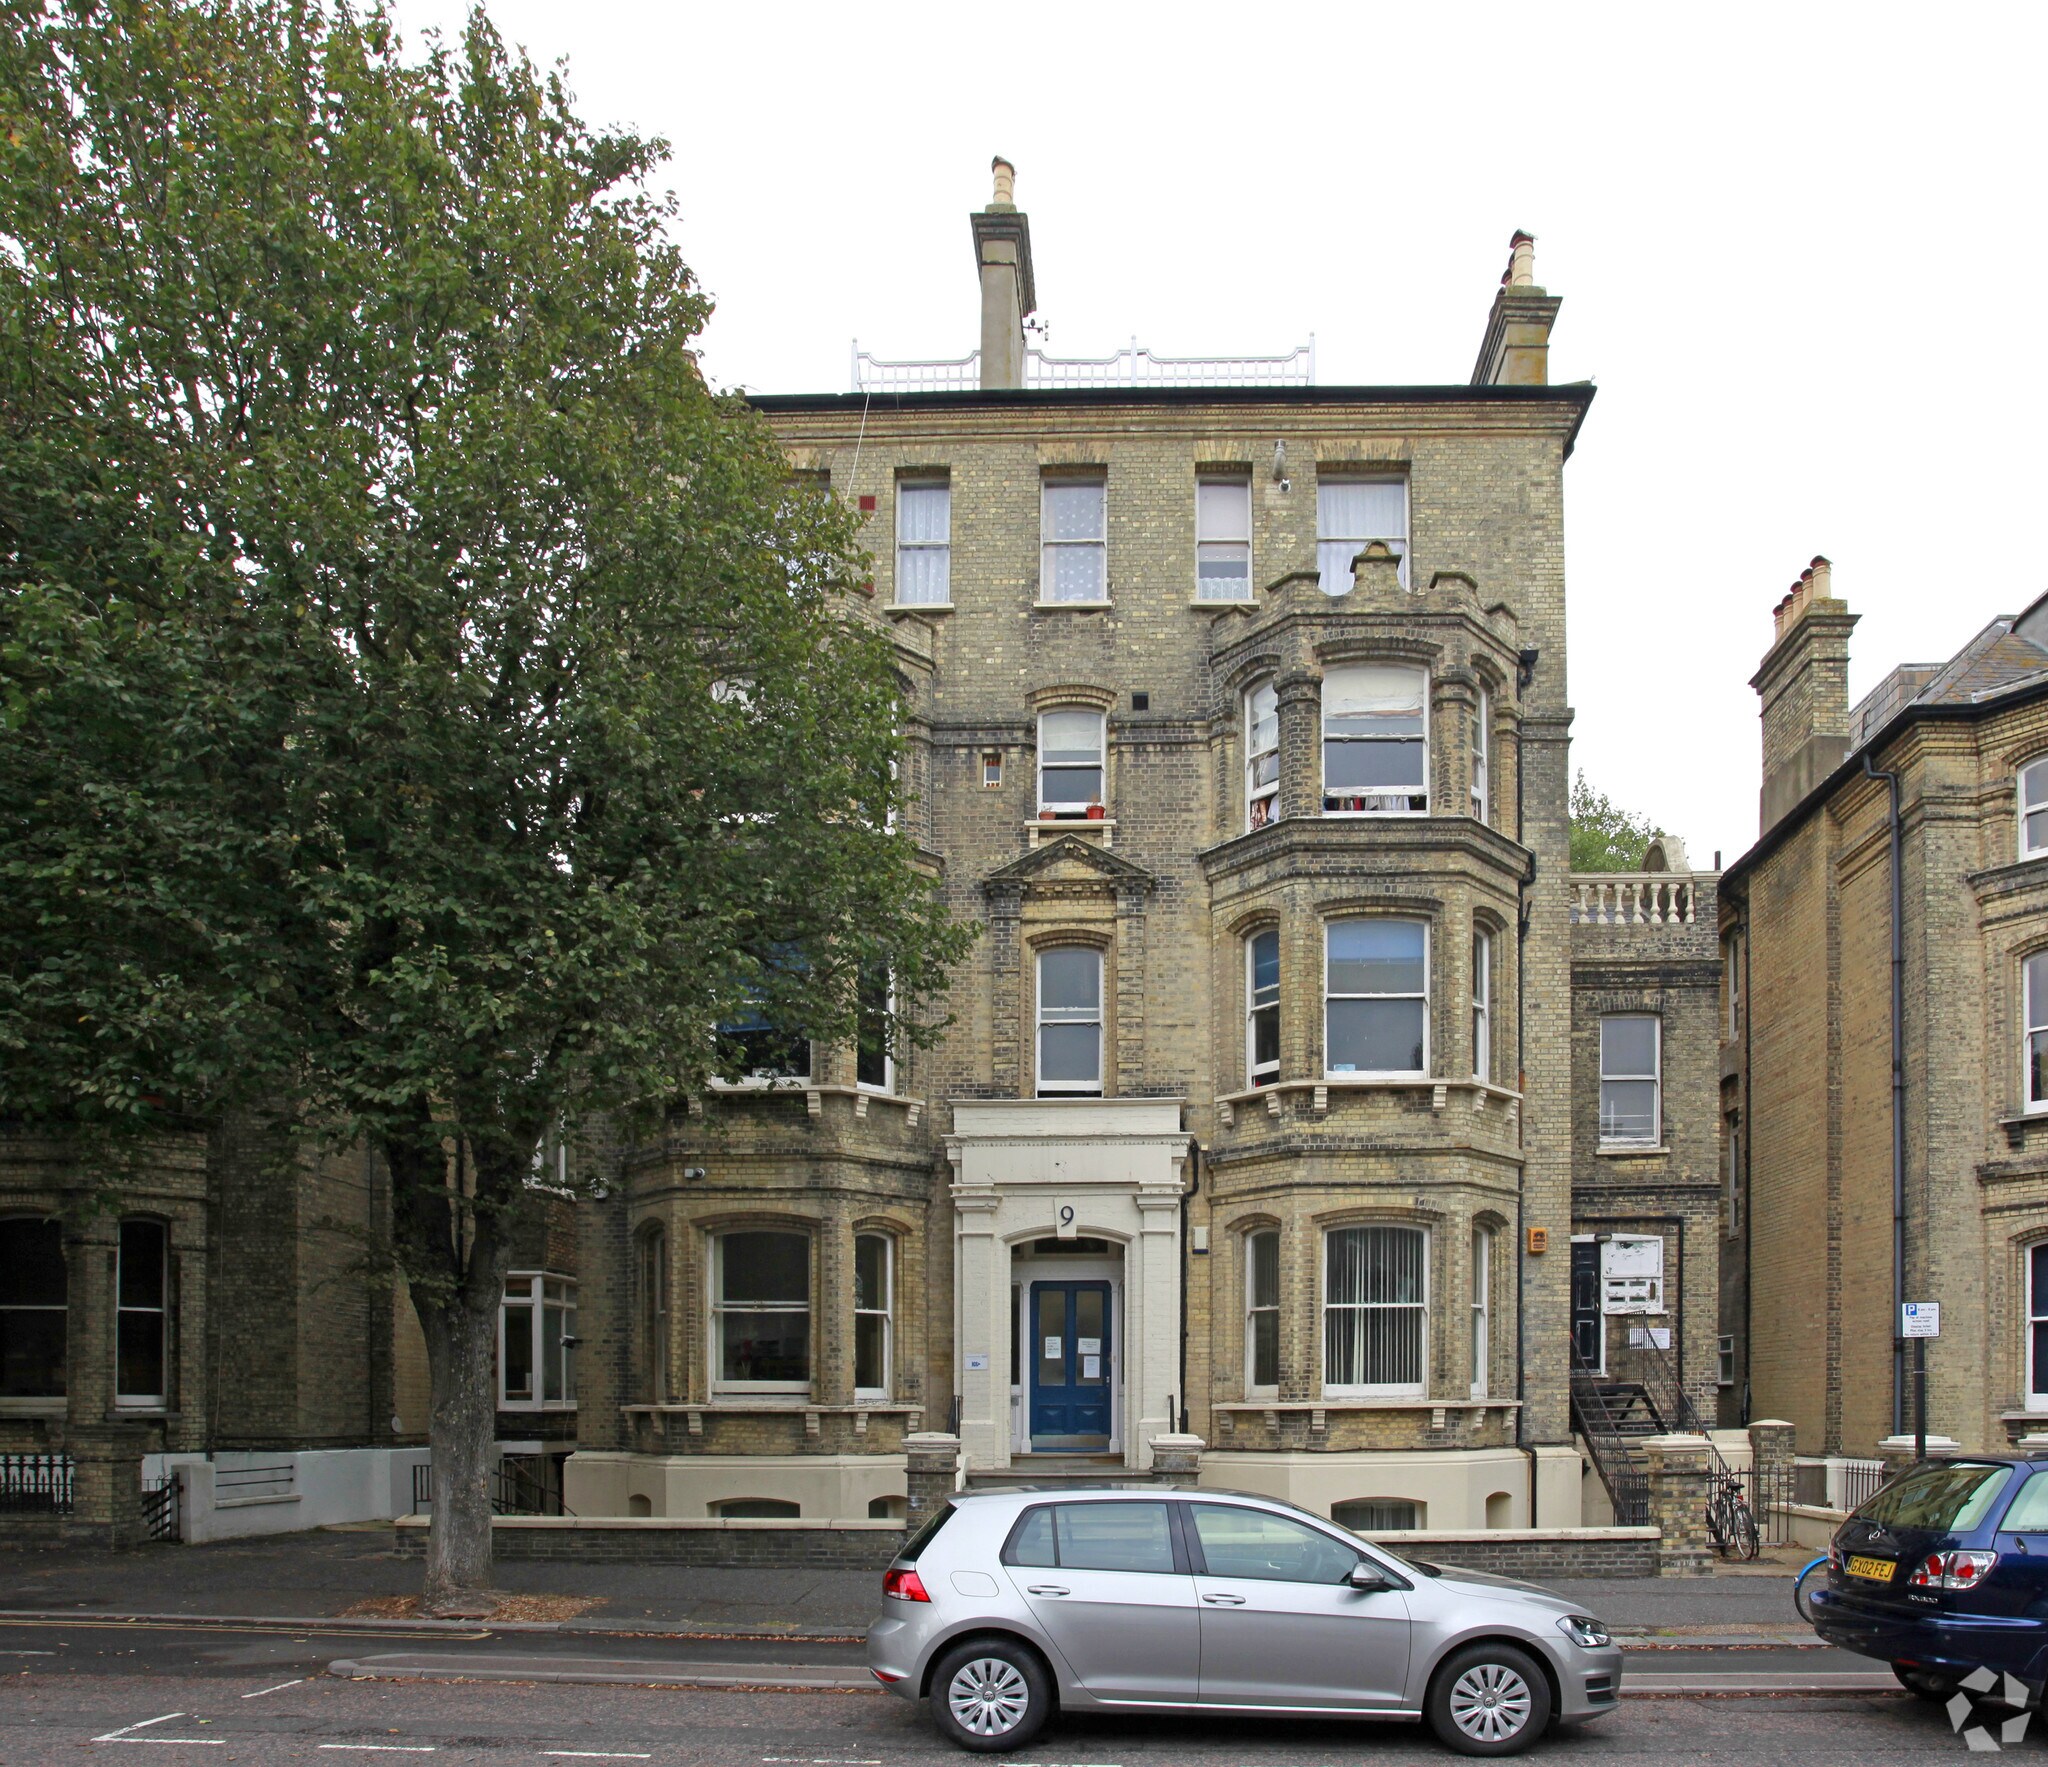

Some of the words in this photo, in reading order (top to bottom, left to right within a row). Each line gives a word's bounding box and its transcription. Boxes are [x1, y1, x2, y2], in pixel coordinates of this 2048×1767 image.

[1060, 1205, 1074, 1228] 9
[1908, 1305, 1916, 1315] P
[1851, 1559, 1873, 1575] GX02
[1873, 1562, 1893, 1578] FEJ
